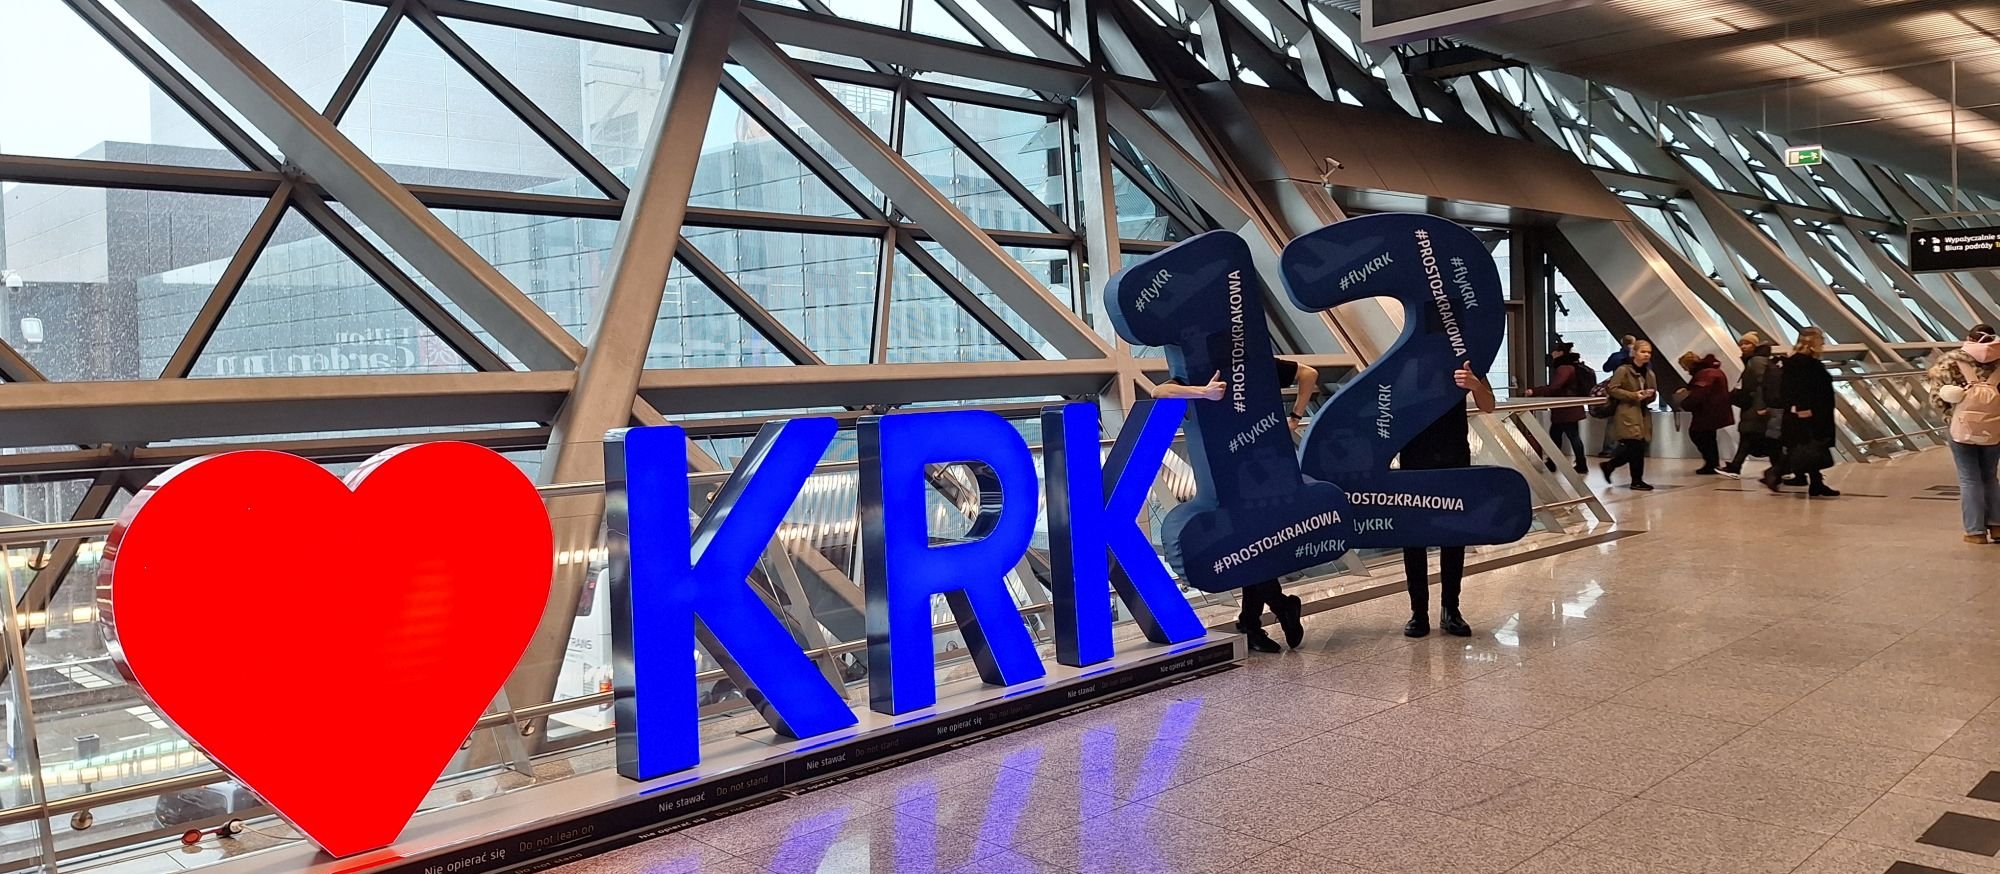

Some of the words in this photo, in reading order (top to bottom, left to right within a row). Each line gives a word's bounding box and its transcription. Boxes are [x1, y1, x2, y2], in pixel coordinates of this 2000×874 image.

[1944, 234, 1995, 244] Wypożyczalnie
[1965, 242, 1993, 251] podróży
[1339, 251, 1394, 291] #flyKRK
[1450, 256, 1478, 310] #flyKRK
[1135, 269, 1172, 312] #flyKR
[1415, 229, 1467, 357] #PROSTOzKRAKOWA
[1228, 269, 1246, 413] #PROSTOzKRAKOWA
[1376, 384, 1394, 439] #flyKRK
[1228, 412, 1280, 453] #flyKRK
[1345, 492, 1465, 511] ROSTOzKRAKOWA
[1353, 517, 1394, 534] lyKRK
[1213, 510, 1342, 574] #PROSTOzKRAKOWA
[1295, 539, 1346, 558] #flyKRK
[604, 398, 1207, 780] KRK
[567, 636, 593, 650] RANS
[936, 726, 948, 735] Nie
[949, 719, 972, 732] opierać
[974, 716, 983, 725] się
[806, 761, 819, 771] Nie
[821, 753, 847, 767] stawać
[716, 786, 728, 797] Do
[730, 782, 745, 794] not
[746, 775, 769, 791] stand
[658, 801, 674, 813] Nie
[676, 792, 706, 808] stawać
[519, 841, 533, 852] Do
[536, 835, 553, 849] not
[556, 829, 578, 842] lean
[581, 824, 595, 835] on
[424, 866, 444, 874] Nie
[447, 852, 487, 872] opierać
[490, 848, 506, 859] się
